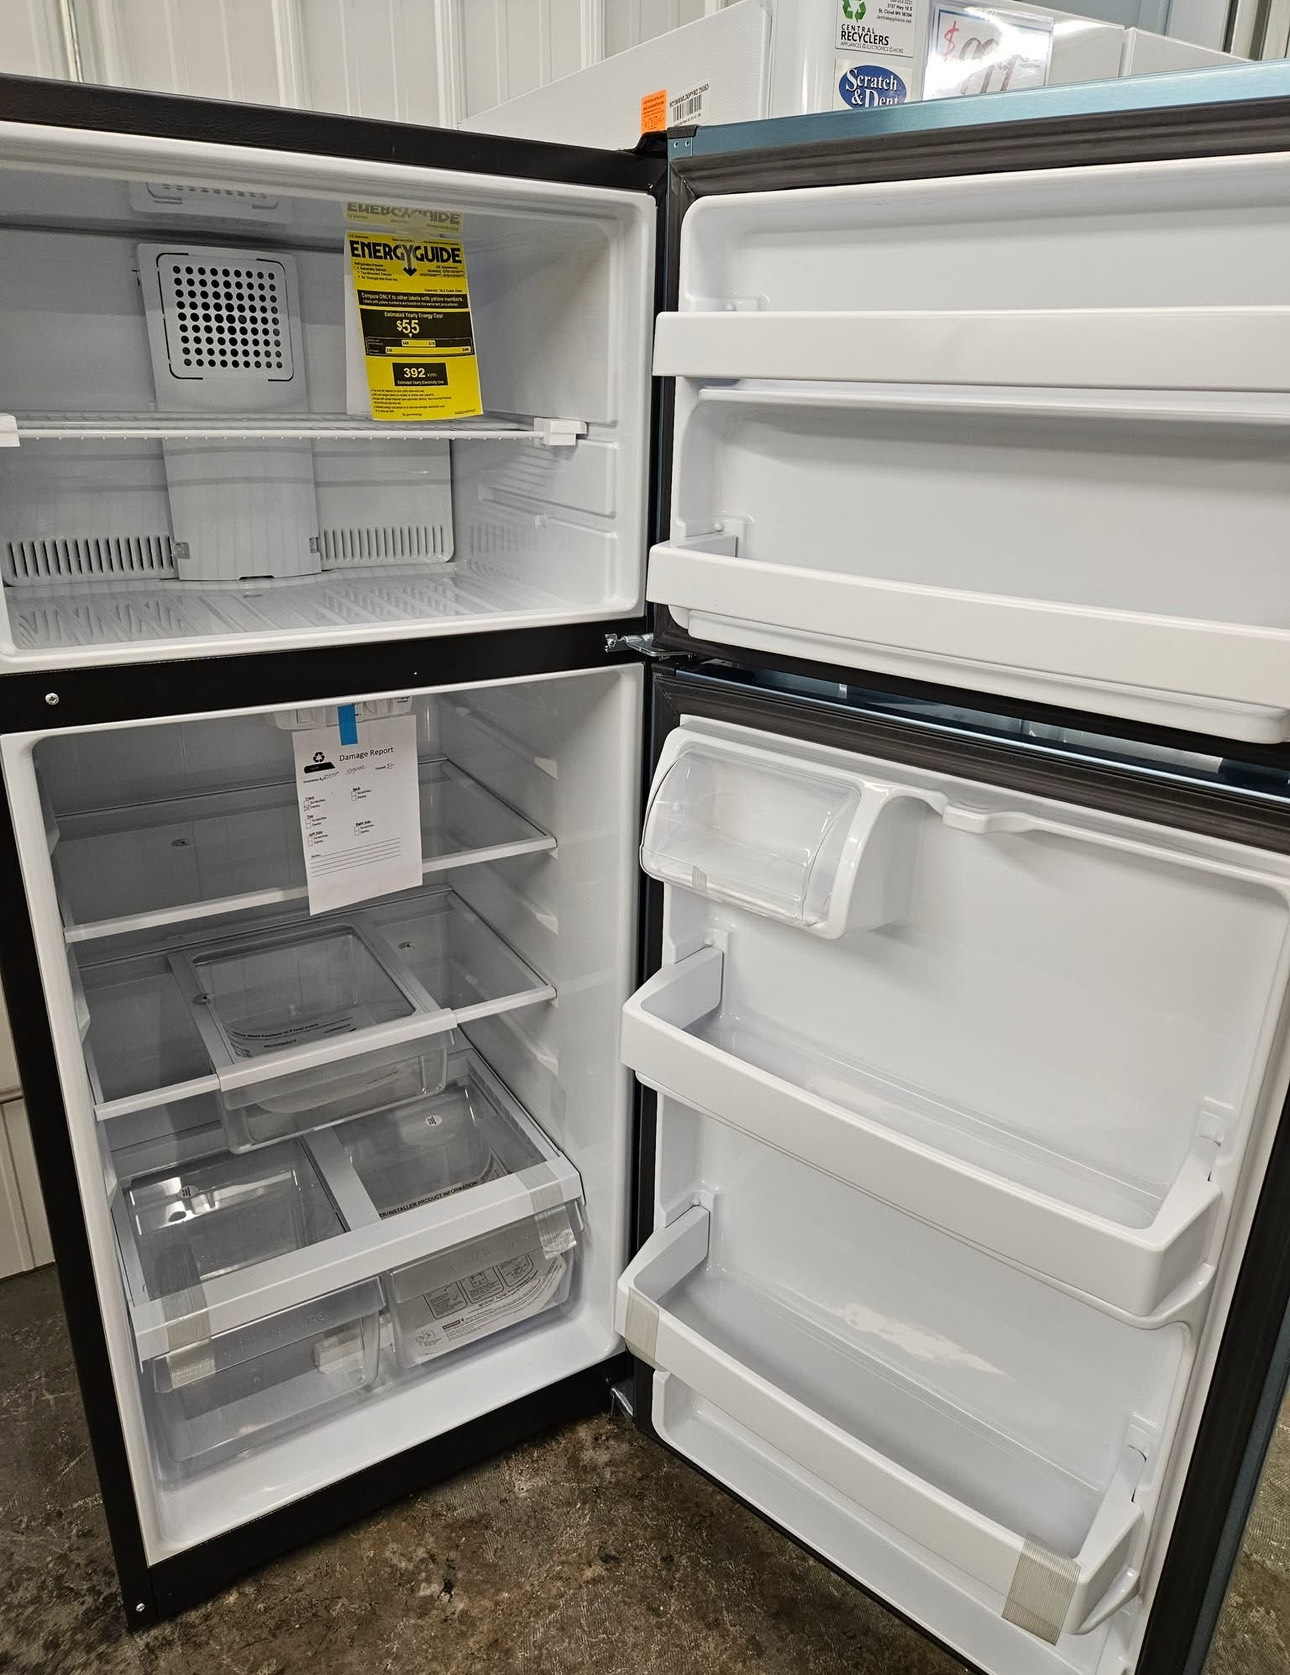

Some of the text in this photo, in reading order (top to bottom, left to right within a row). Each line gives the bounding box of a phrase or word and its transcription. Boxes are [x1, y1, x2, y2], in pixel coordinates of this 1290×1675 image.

[841, 24, 875, 34] CENTRAL
[840, 31, 889, 46] RECYCLERS
[846, 68, 897, 91] Scratch
[851, 88, 899, 108] & Dent
[396, 319, 420, 334] $55
[403, 368, 426, 378] 392
[339, 747, 394, 762] Damage Report
[418, 1194, 442, 1206] PRODUCT
[443, 1181, 478, 1196] INFORMATION
